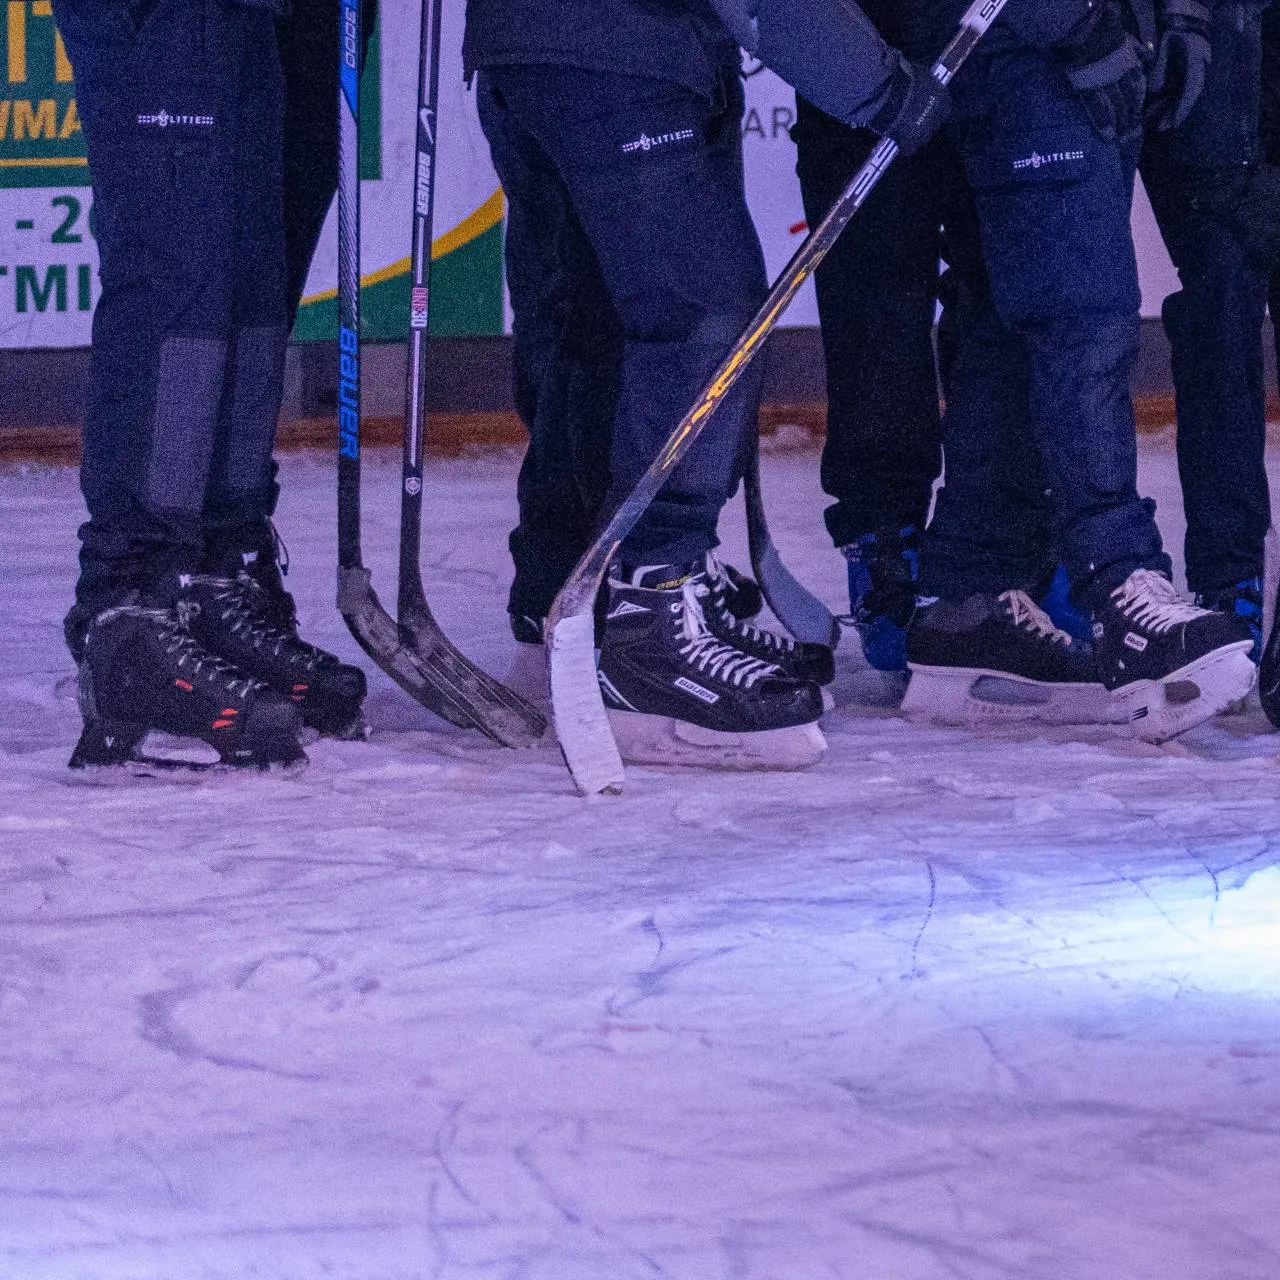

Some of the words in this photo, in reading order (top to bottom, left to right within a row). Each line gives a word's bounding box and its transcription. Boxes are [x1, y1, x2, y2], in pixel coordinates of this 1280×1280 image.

[417, 151, 431, 216] BAUER
[340, 327, 358, 459] BAUER
[679, 679, 714, 701] BAUER
